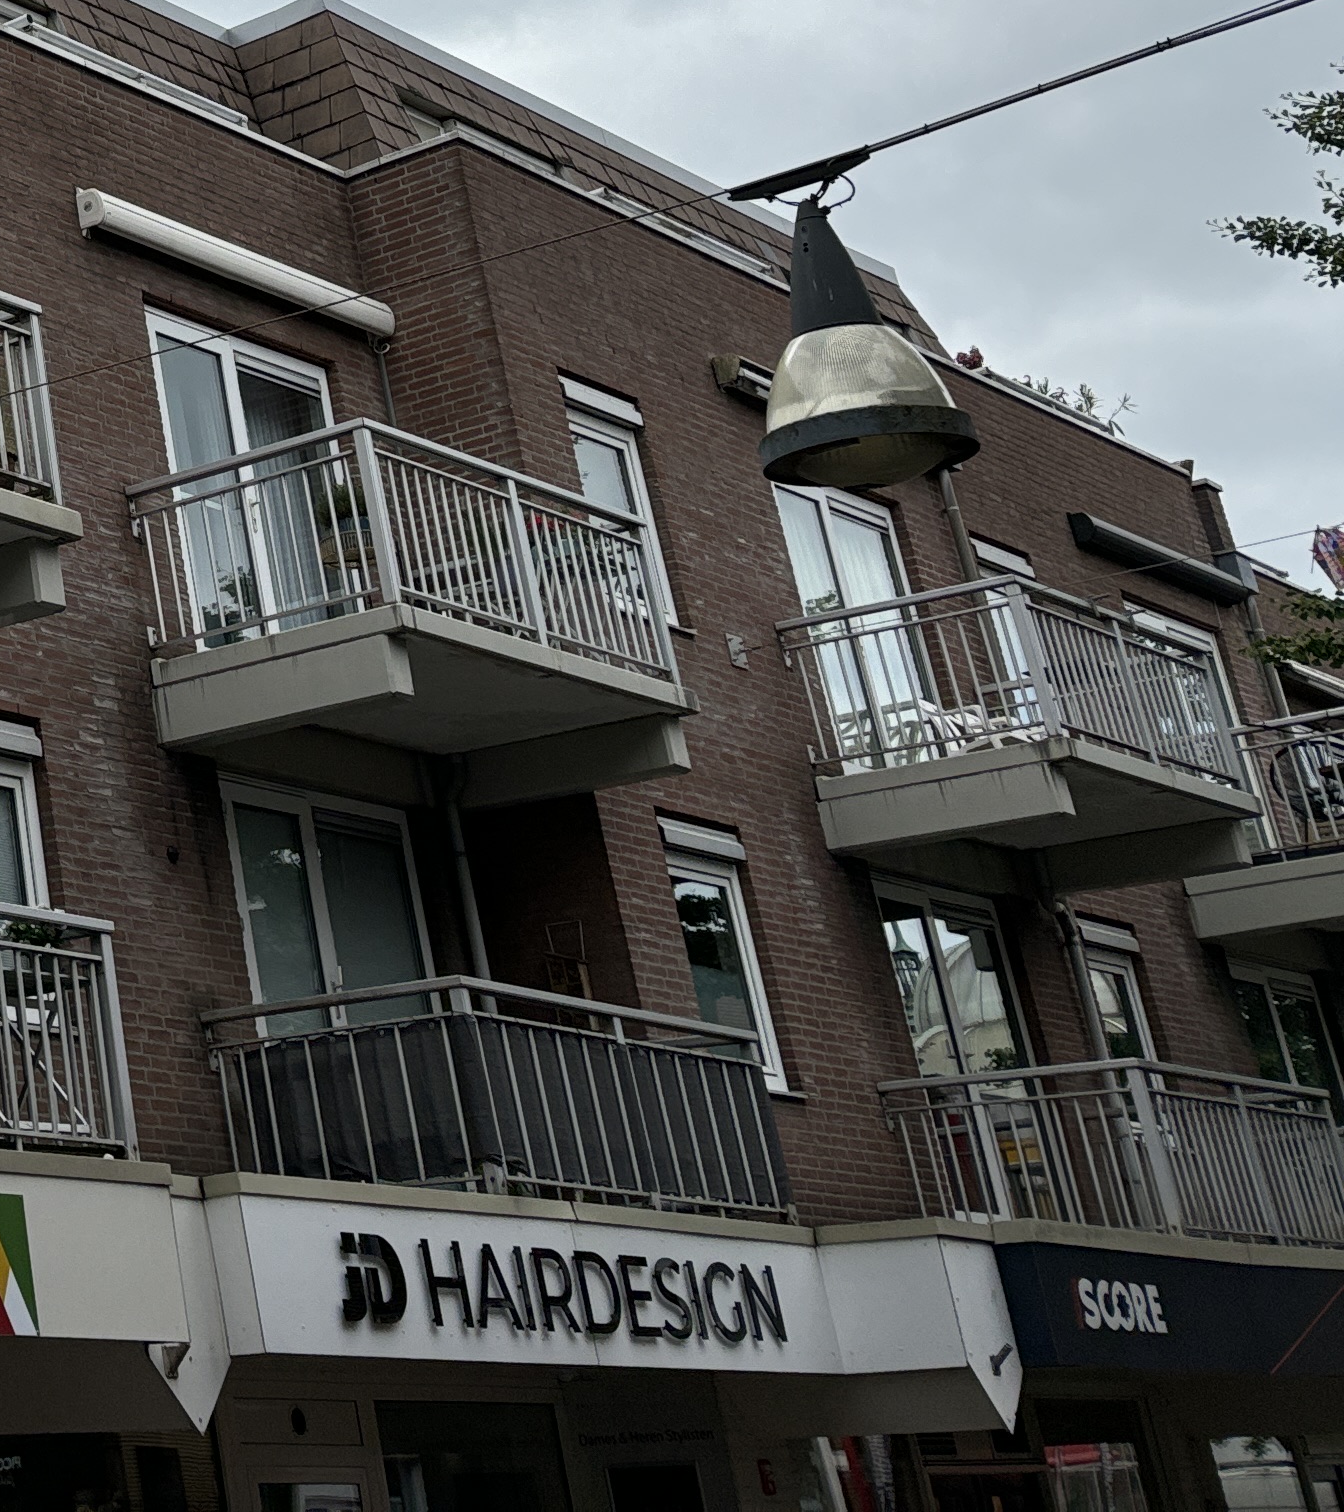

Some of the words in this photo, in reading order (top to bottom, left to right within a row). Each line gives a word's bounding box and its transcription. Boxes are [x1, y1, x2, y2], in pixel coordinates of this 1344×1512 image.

[418, 1238, 790, 1344] HAIRDESIGN
[1077, 1276, 1170, 1335] SCORE
[578, 1433, 616, 1447] Dames
[618, 1432, 628, 1445] &
[630, 1430, 664, 1445] Heren
[665, 1428, 715, 1444] Stylisten
